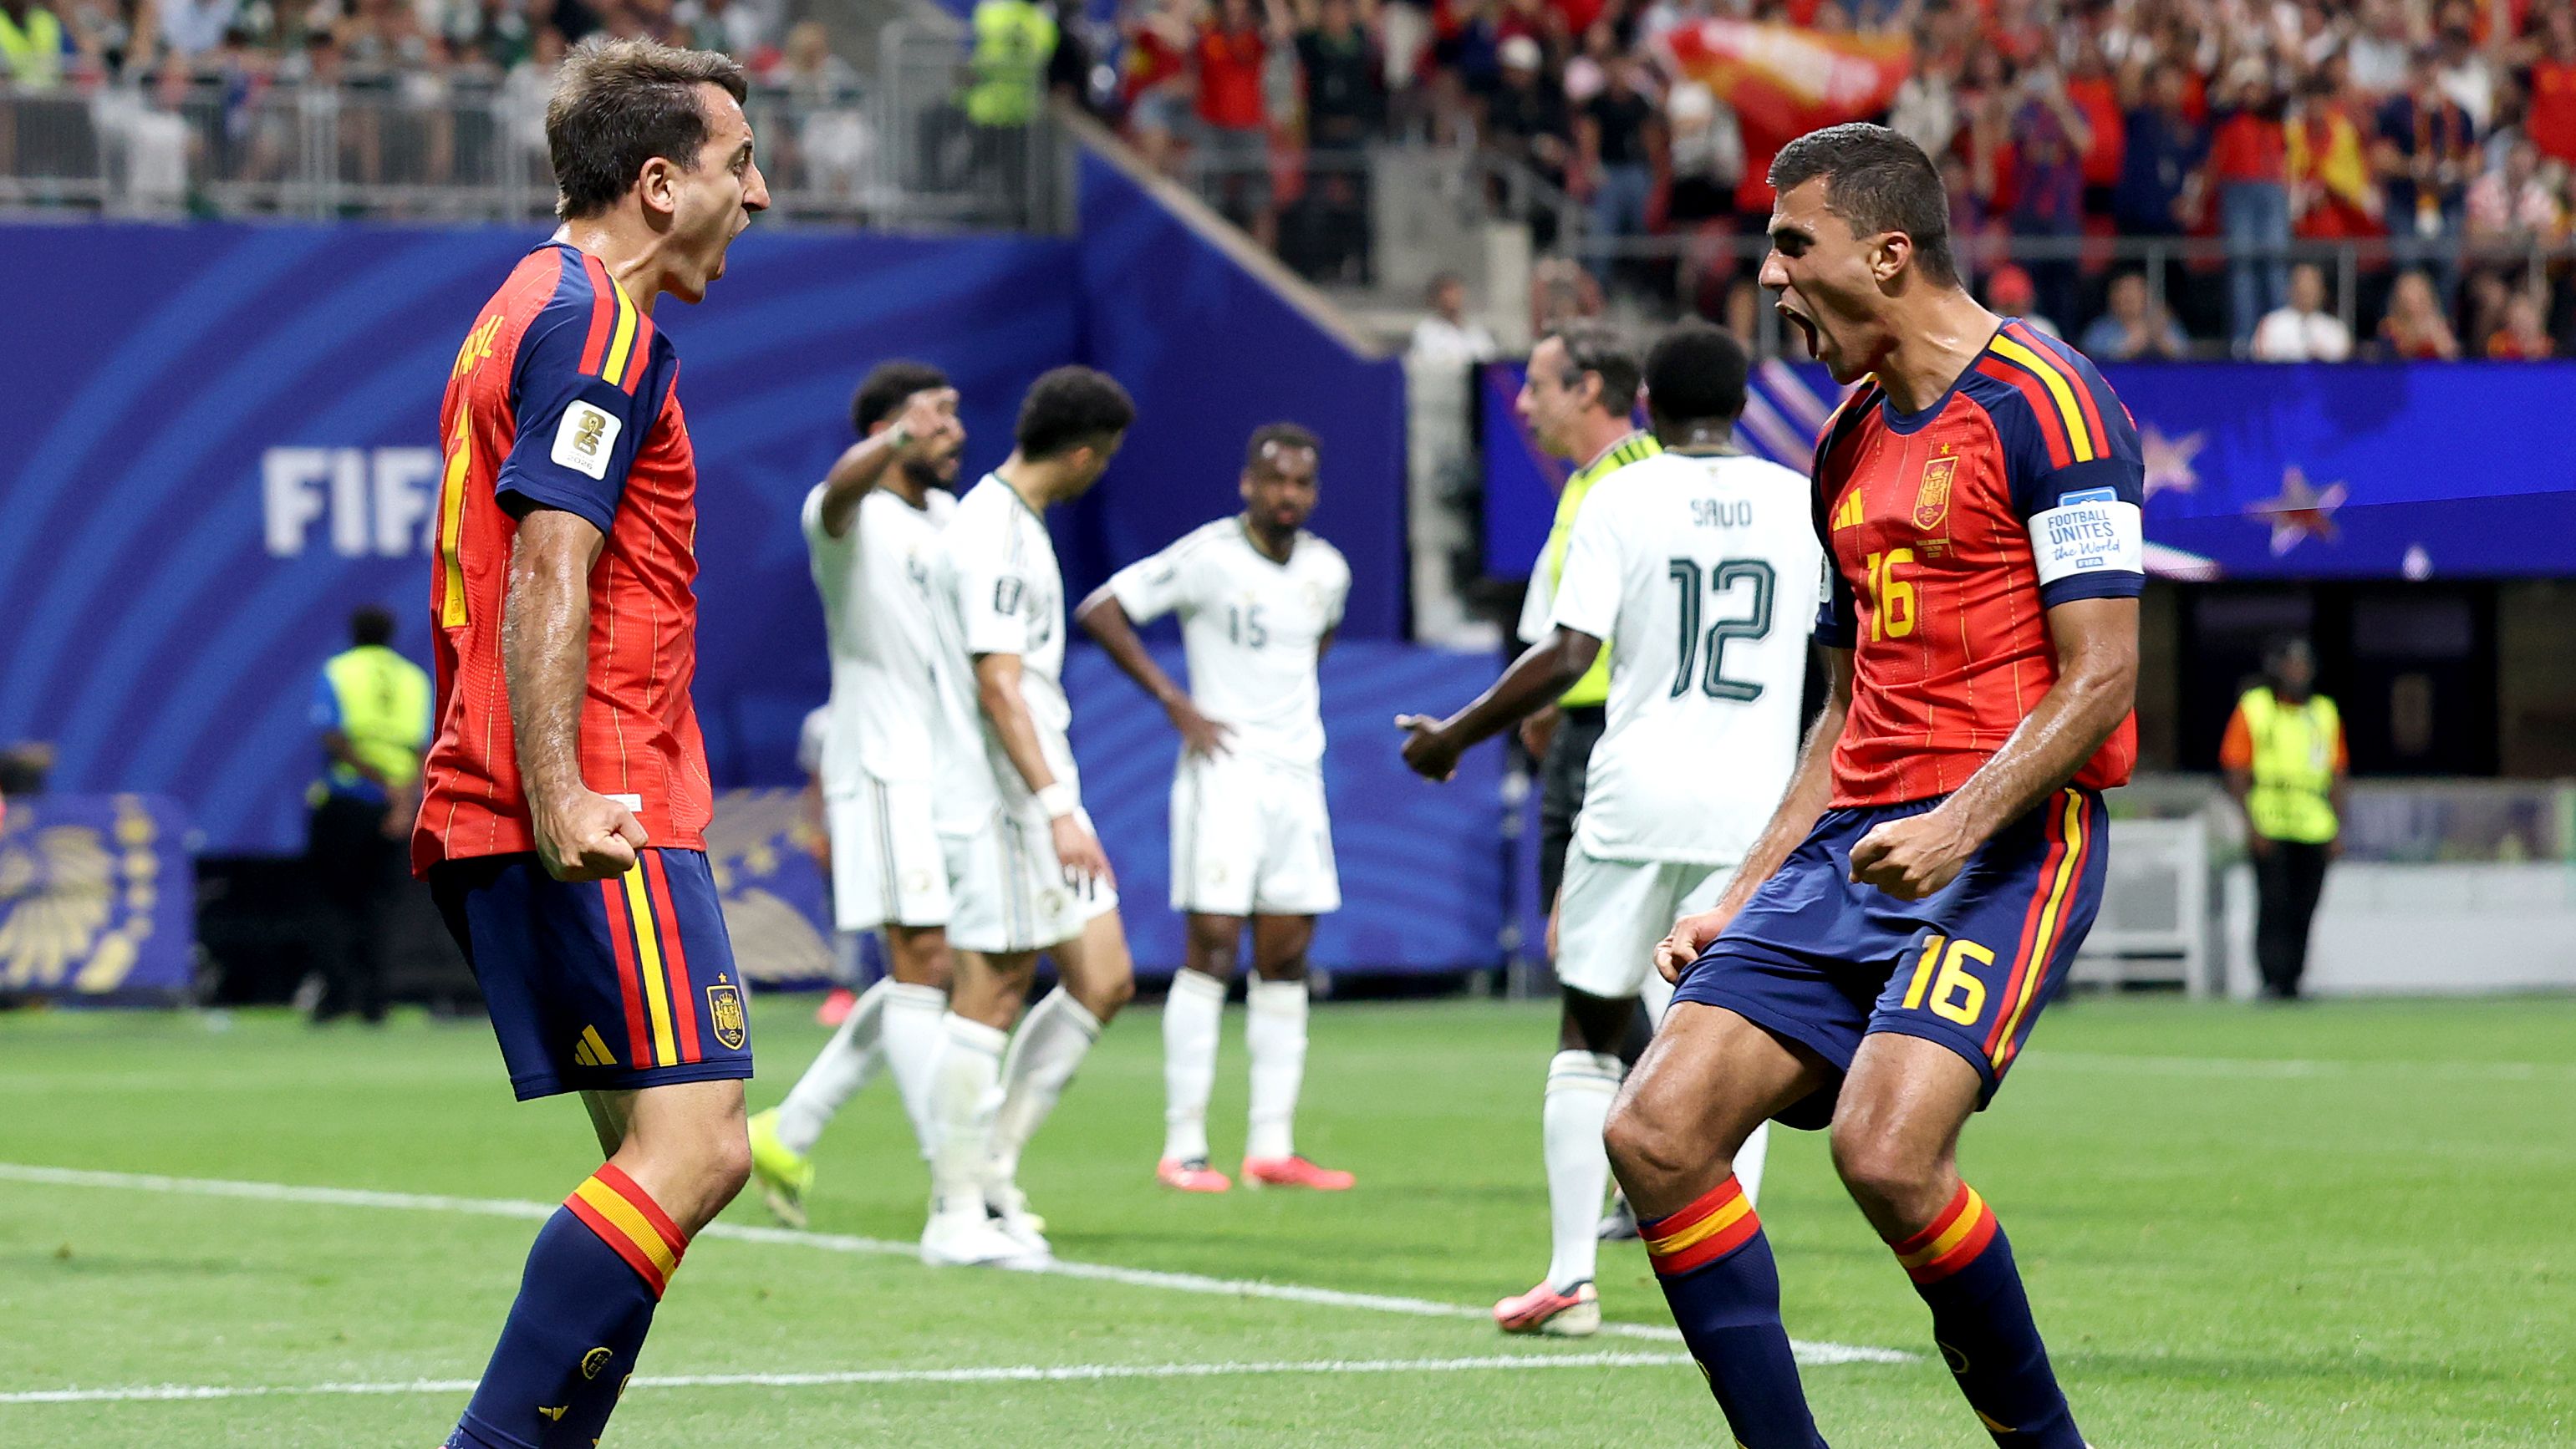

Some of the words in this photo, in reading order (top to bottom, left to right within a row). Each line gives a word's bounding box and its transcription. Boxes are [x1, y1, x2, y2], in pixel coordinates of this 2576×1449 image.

[262, 445, 440, 558] FIF
[2048, 509, 2110, 528] FOOTBALL
[2049, 522, 2114, 545] UNITES
[2052, 546, 2077, 561] the
[2079, 538, 2120, 555] World
[1227, 603, 1268, 649] 15
[1866, 547, 1915, 643] 16
[1669, 557, 1776, 704] 12
[1901, 934, 1996, 1027] 16
